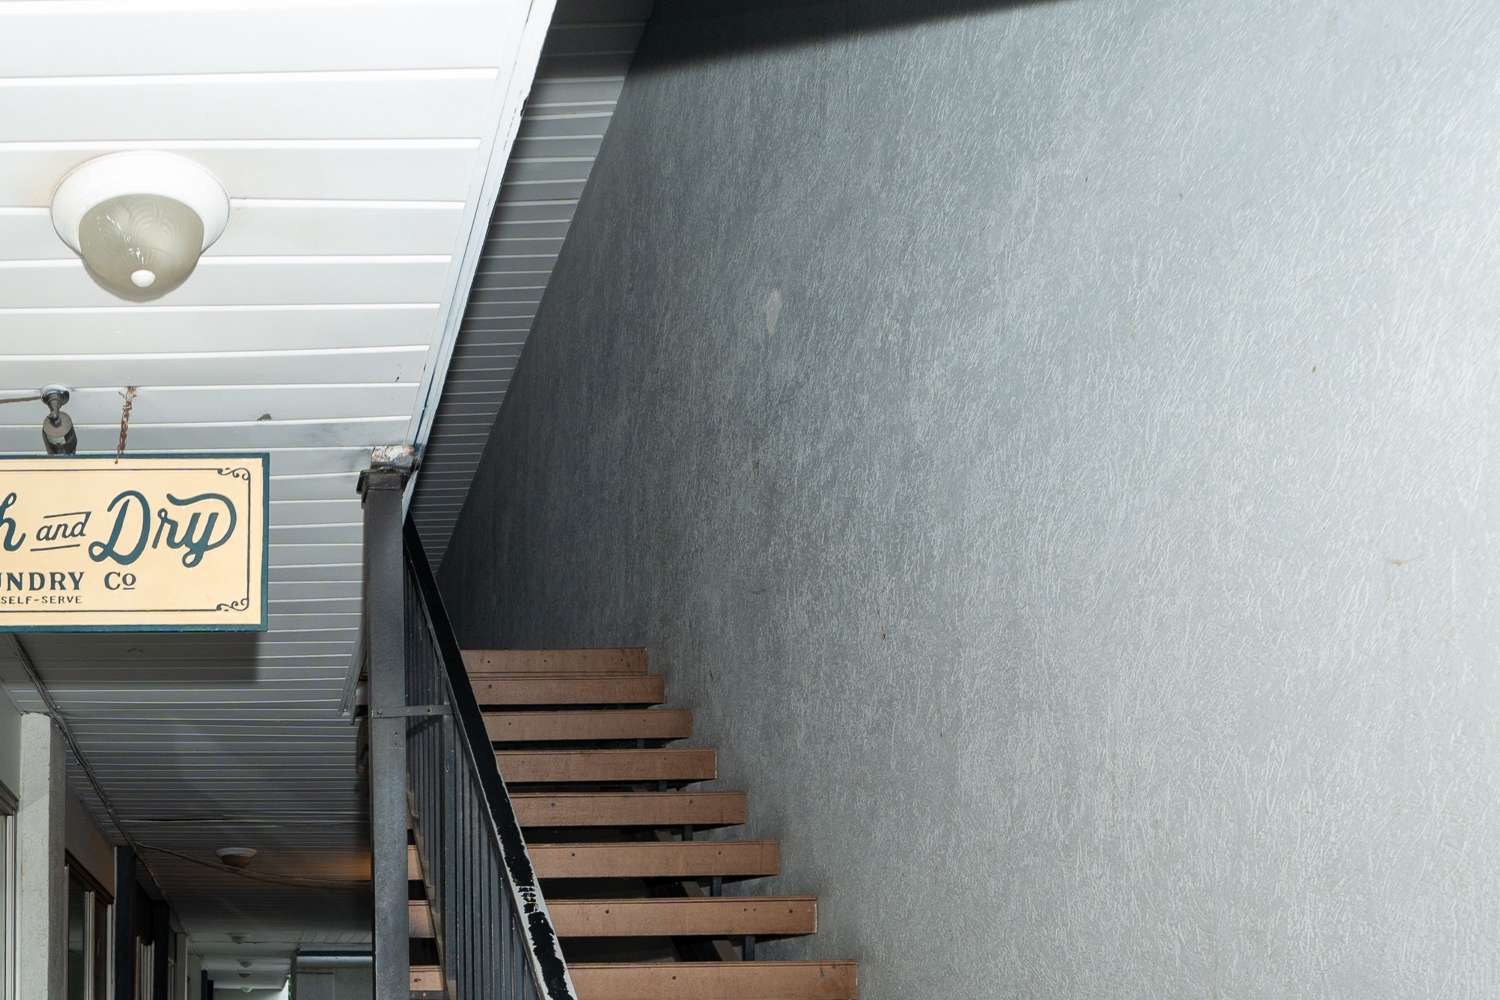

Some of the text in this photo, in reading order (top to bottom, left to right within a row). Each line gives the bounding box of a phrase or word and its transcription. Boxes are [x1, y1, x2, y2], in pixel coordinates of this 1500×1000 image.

[35, 511, 92, 542] and
[88, 490, 237, 569] Dry
[103, 571, 137, 591] Co
[0, 595, 83, 605] SELF-SERVE
